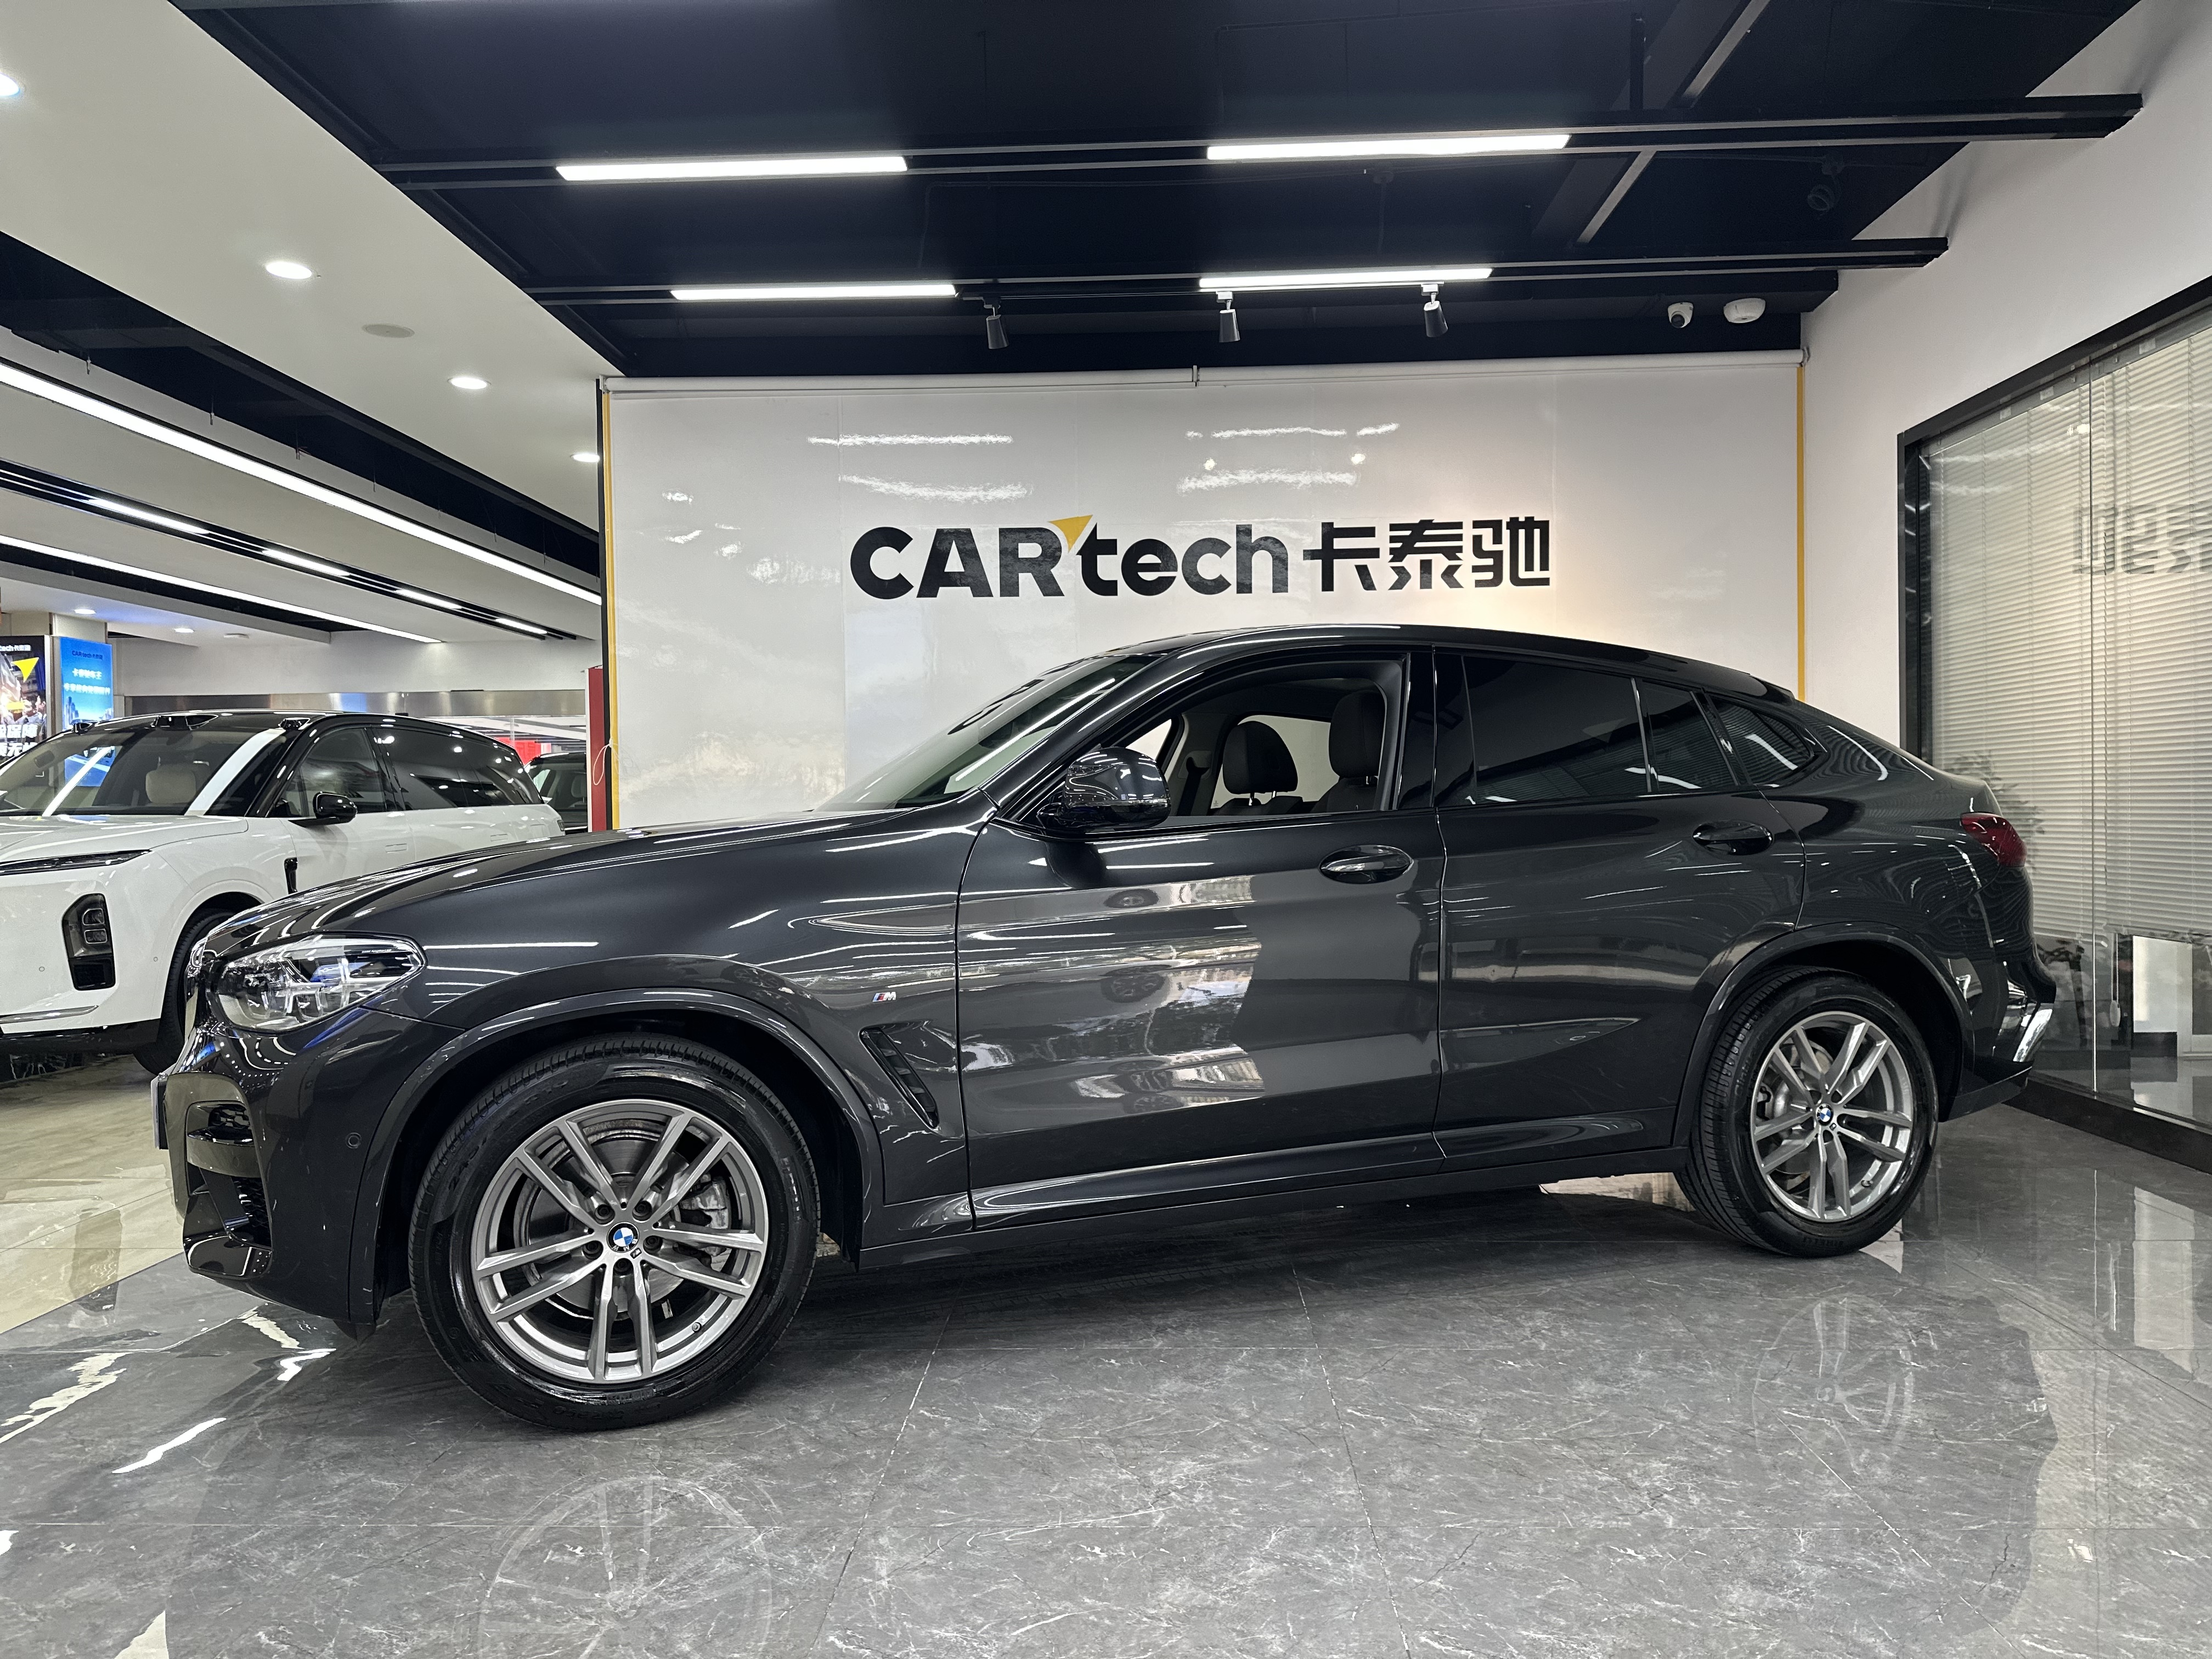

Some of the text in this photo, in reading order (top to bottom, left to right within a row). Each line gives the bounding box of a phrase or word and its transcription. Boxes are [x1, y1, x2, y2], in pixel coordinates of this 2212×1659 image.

[850, 516, 1550, 599] CARtech 卡泰驰
